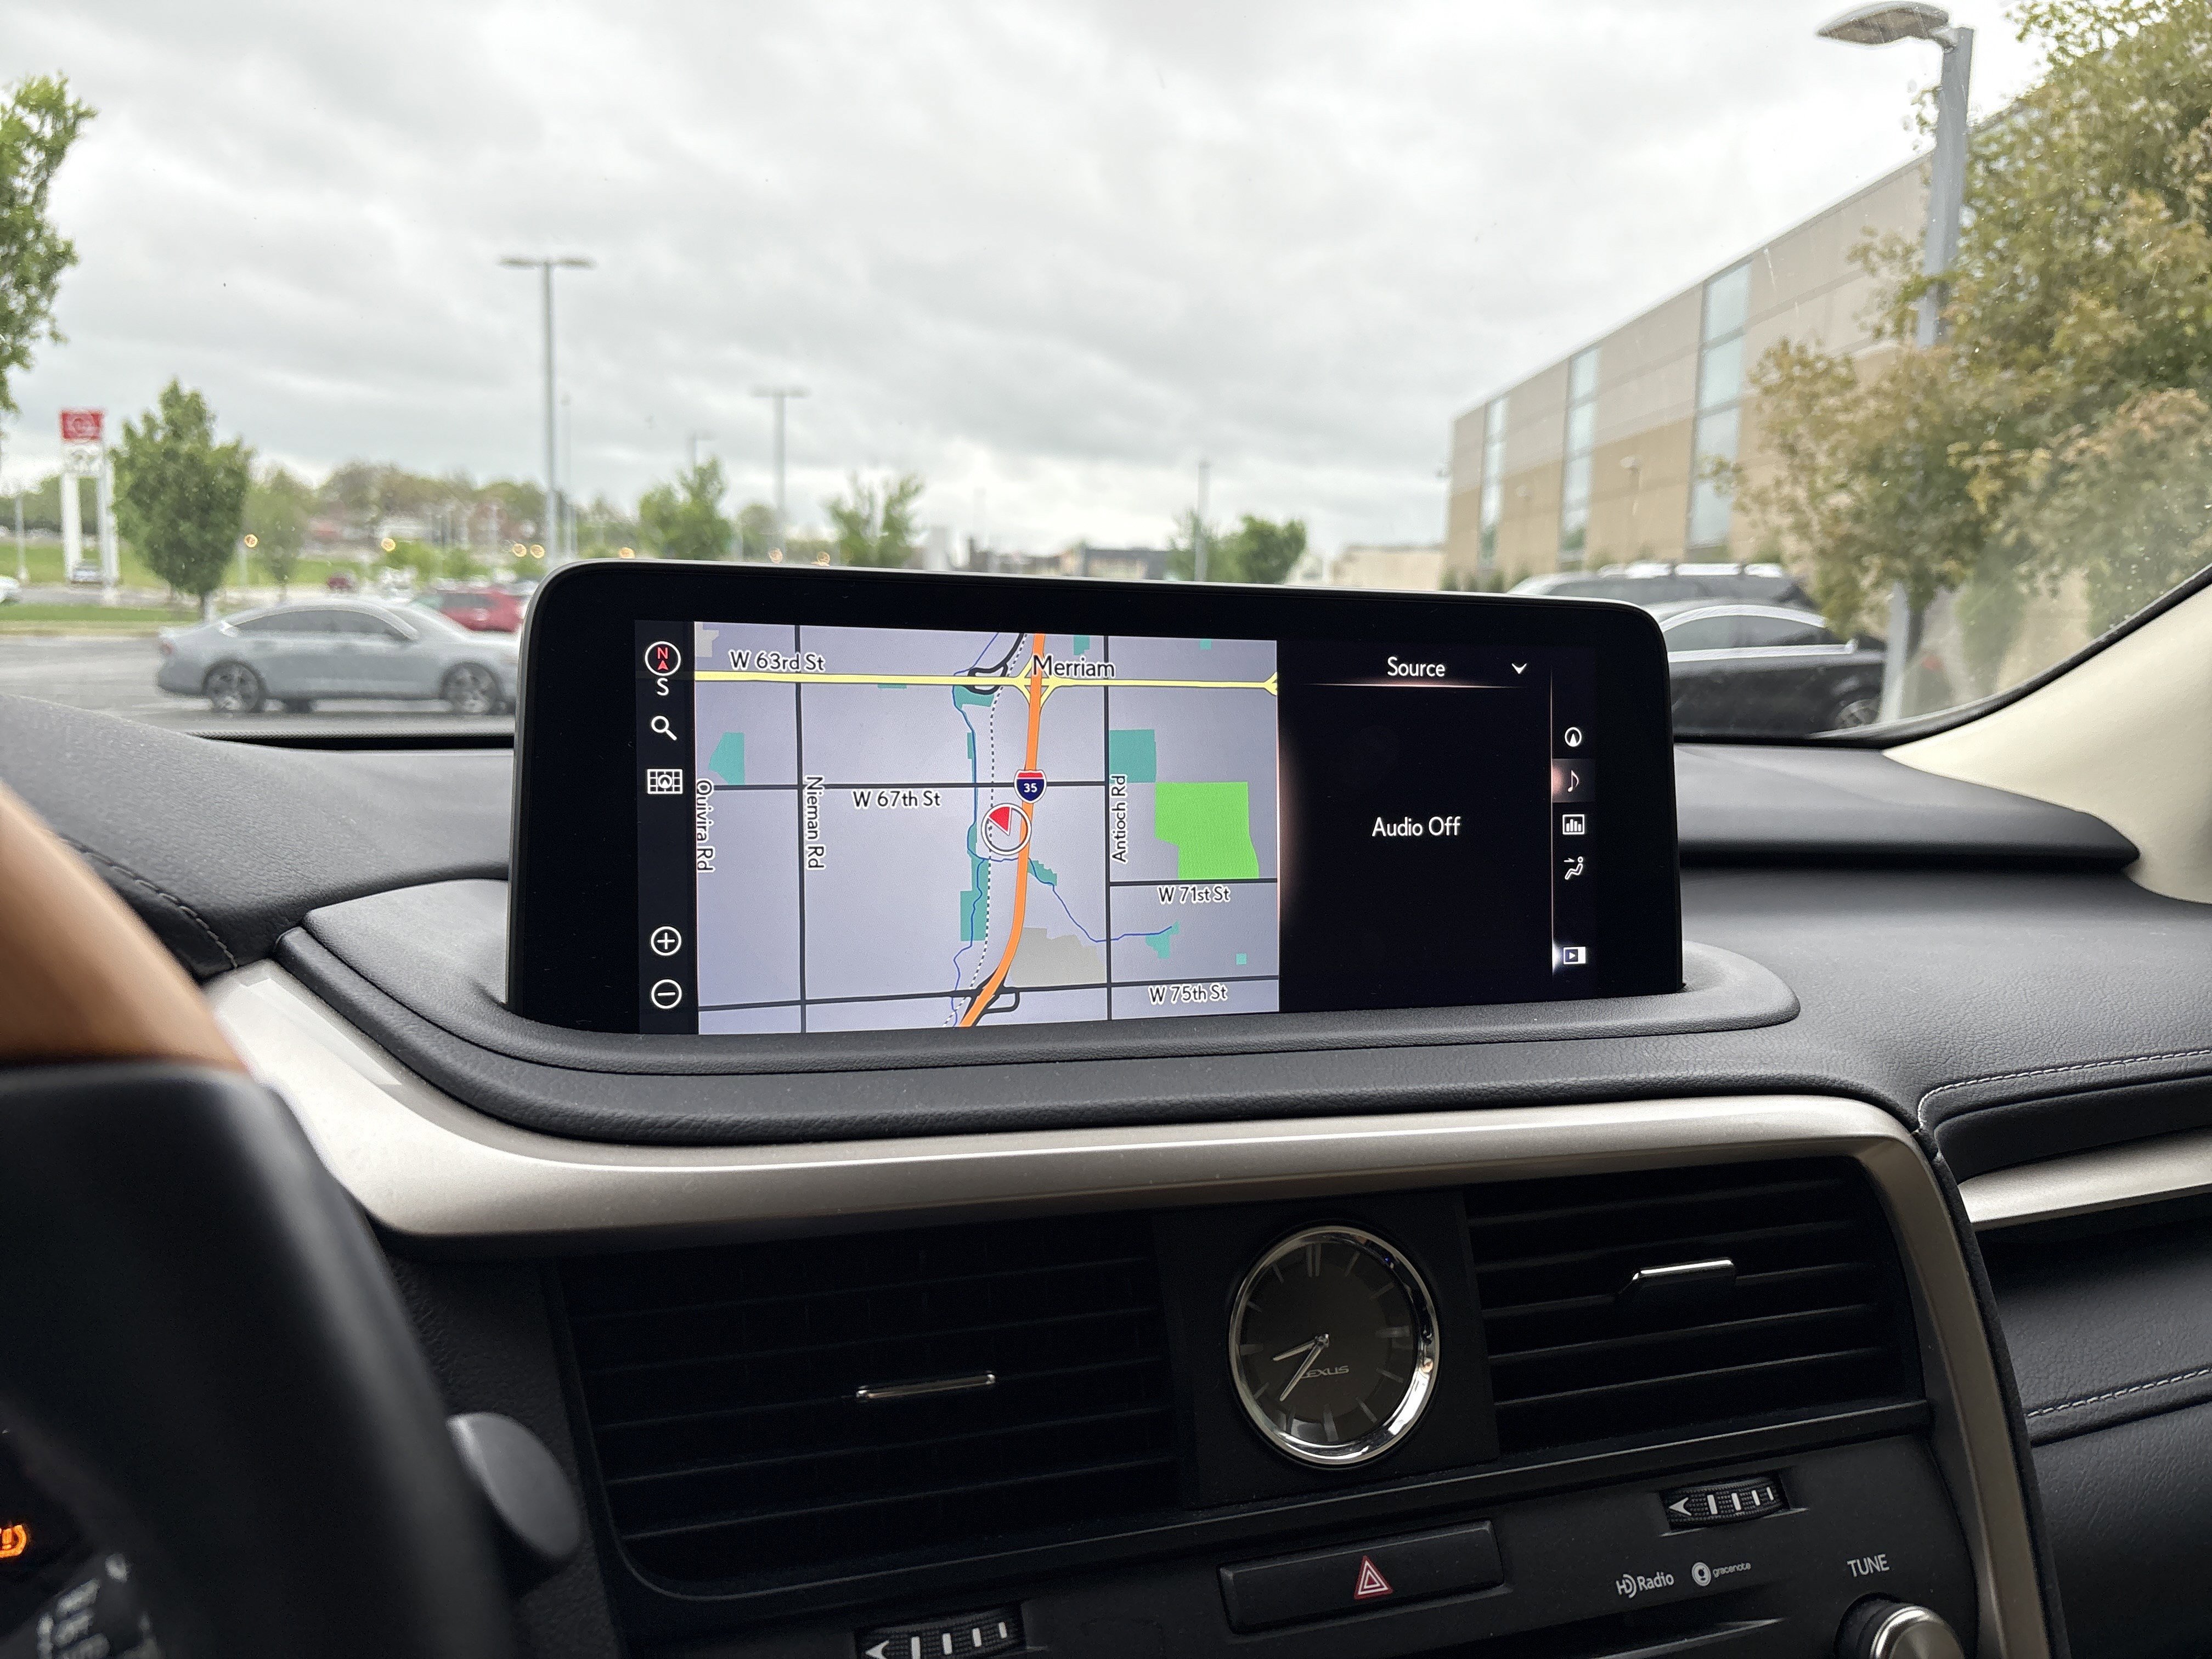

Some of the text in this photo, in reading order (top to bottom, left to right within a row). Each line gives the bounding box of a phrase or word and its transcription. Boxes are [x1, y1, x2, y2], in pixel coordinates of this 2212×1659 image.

[657, 647, 668, 658] N
[730, 651, 824, 670] W 63rd St
[1033, 656, 1115, 678] Merriam
[1387, 657, 1446, 677] Source
[657, 679, 669, 696] S
[1024, 782, 1037, 793] 35
[853, 790, 941, 807] W 67th St
[697, 780, 714, 871] Quivira Rd
[806, 777, 824, 869] Nieman Rd
[1111, 775, 1127, 862] Antioch Rd
[1372, 816, 1461, 836] Audio Off
[1159, 886, 1230, 902] W 71st St
[1150, 985, 1227, 1003] W 75th St
[1712, 1562, 1751, 1578] gracenote
[1847, 1554, 1889, 1577] TUNE
[1637, 1571, 1674, 1591] Radio
